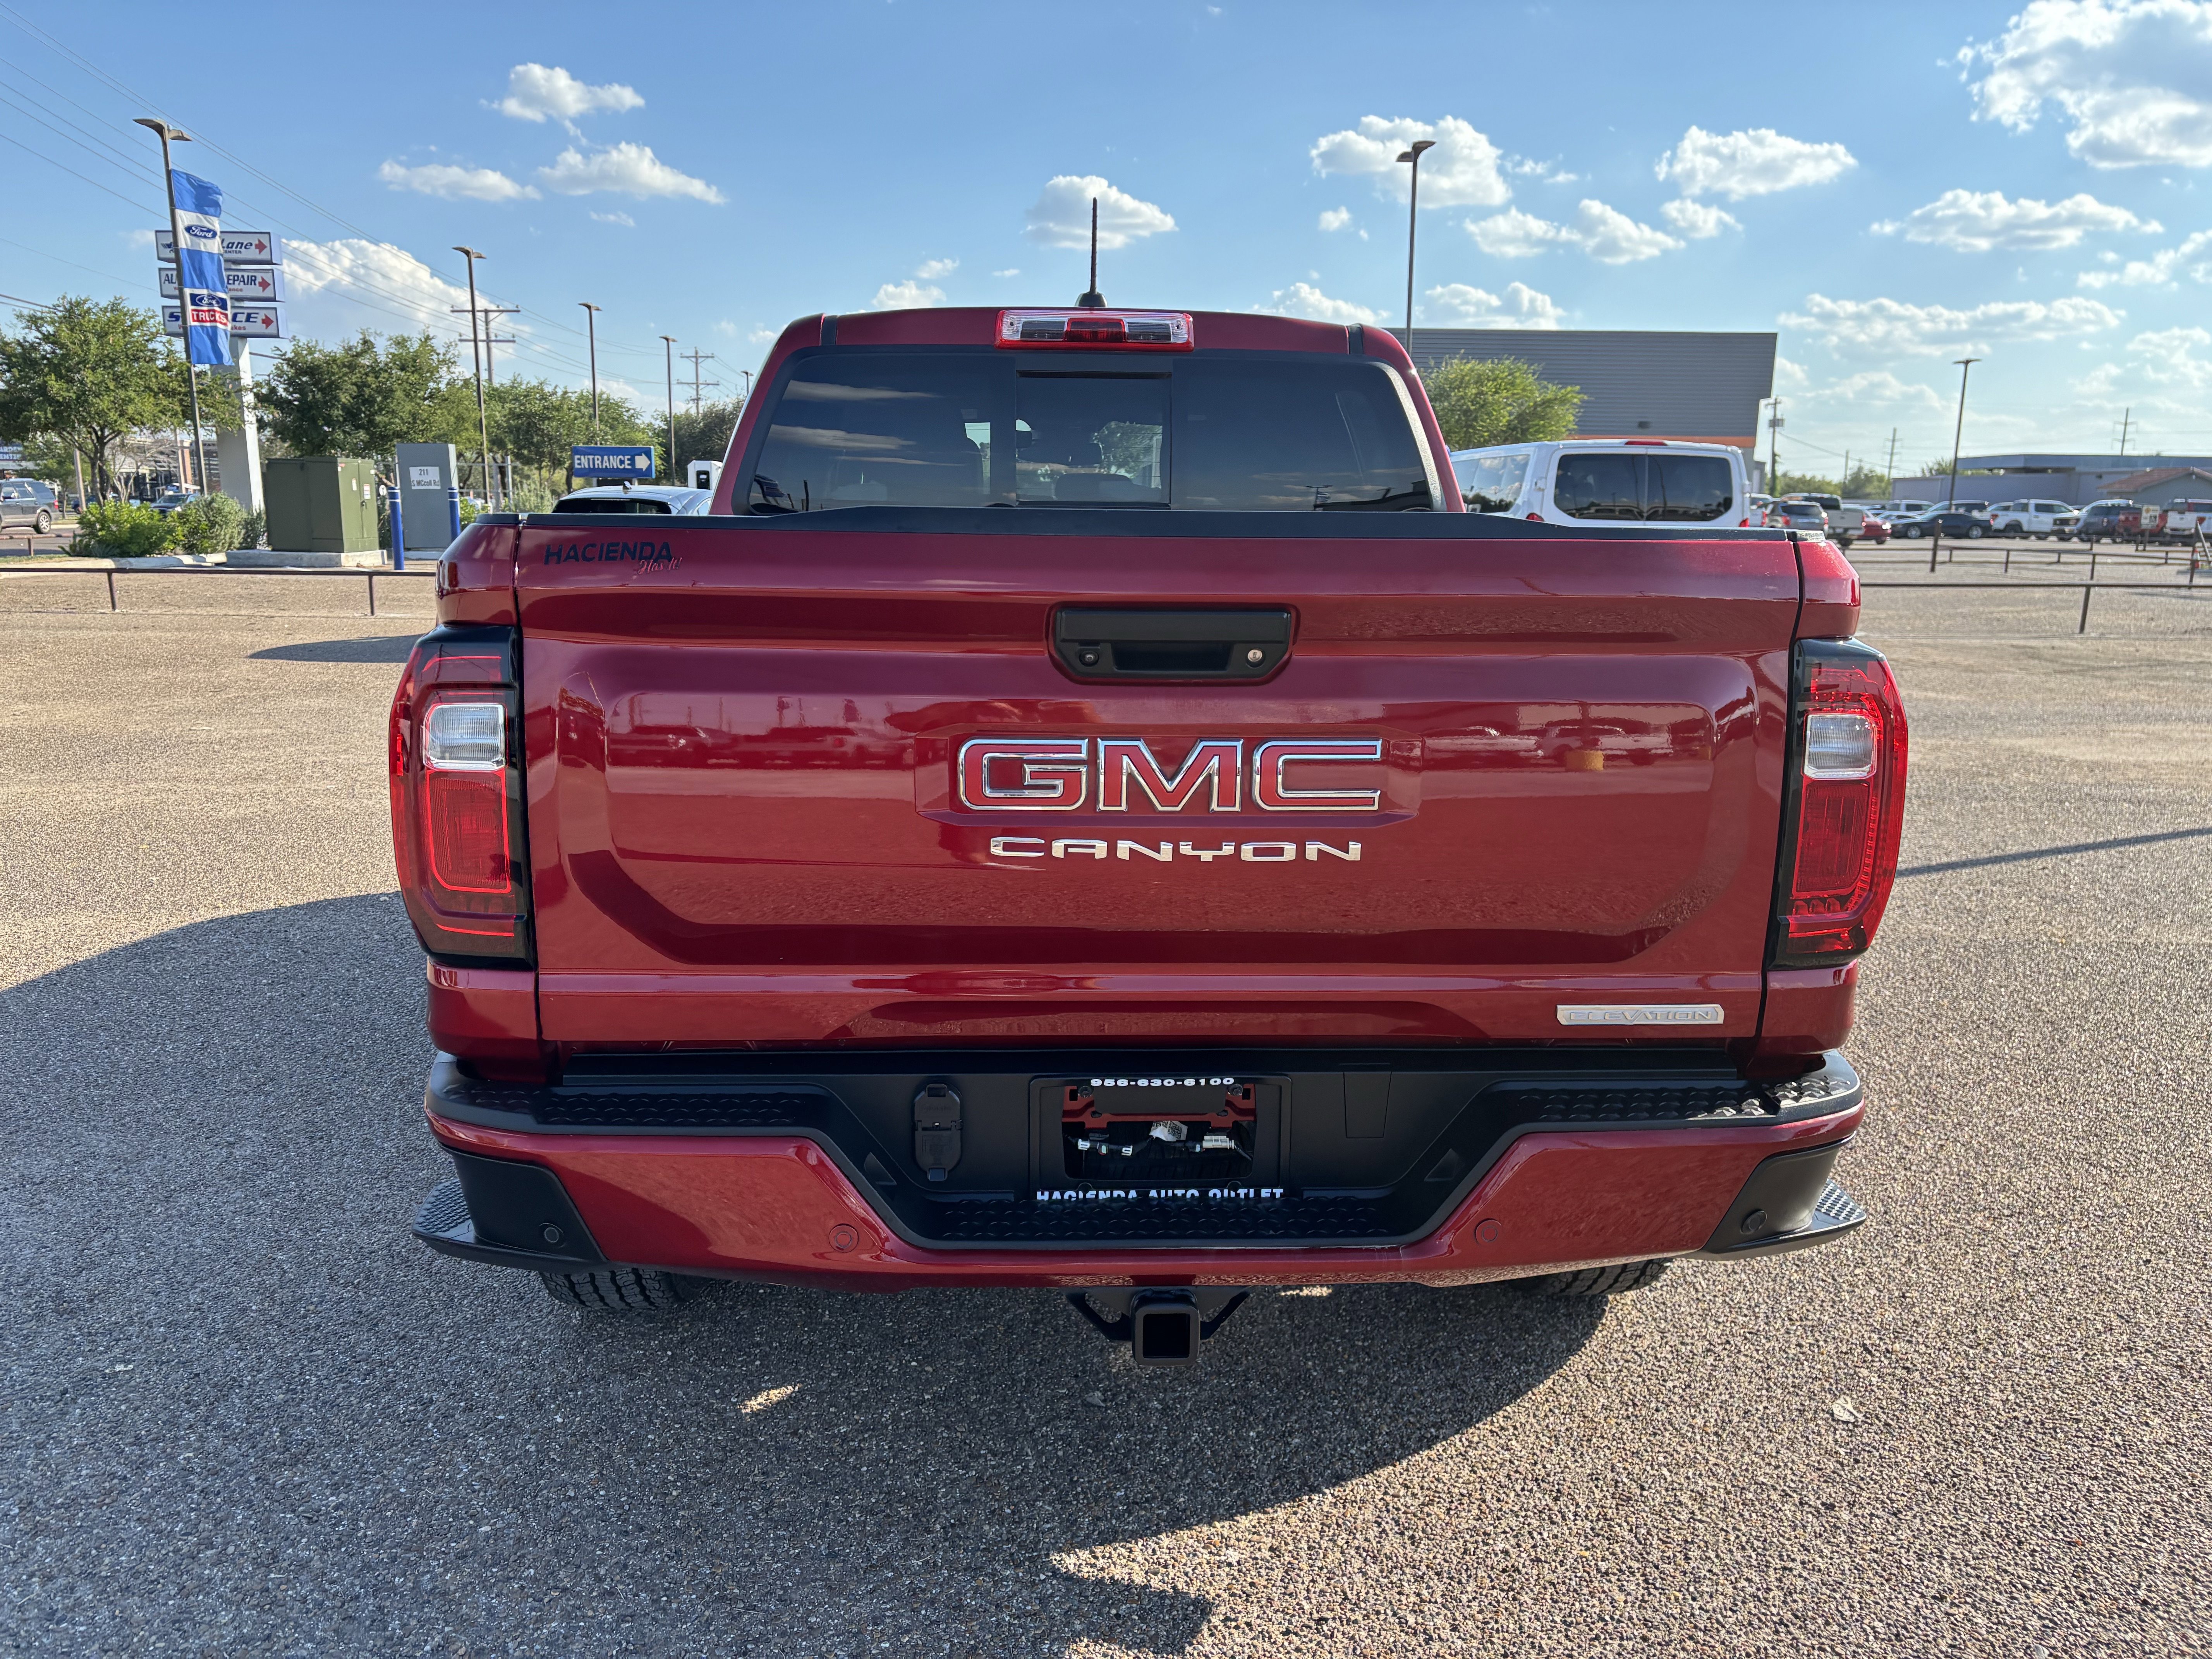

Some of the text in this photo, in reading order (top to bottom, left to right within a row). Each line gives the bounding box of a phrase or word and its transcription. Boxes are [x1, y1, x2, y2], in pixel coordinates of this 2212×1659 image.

[190, 226, 213, 238] Ford
[227, 274, 257, 286] EPAIR
[574, 455, 632, 469] ENTRANCE
[544, 542, 672, 565] HACIENDA
[638, 560, 663, 574] Has
[958, 738, 1382, 812] GMC
[991, 836, 1361, 861] CANYON
[1570, 1009, 1711, 1020] ELEVATION
[1091, 1078, 1234, 1086] 956-630-6100
[1037, 1190, 1137, 1200] HACIENDA
